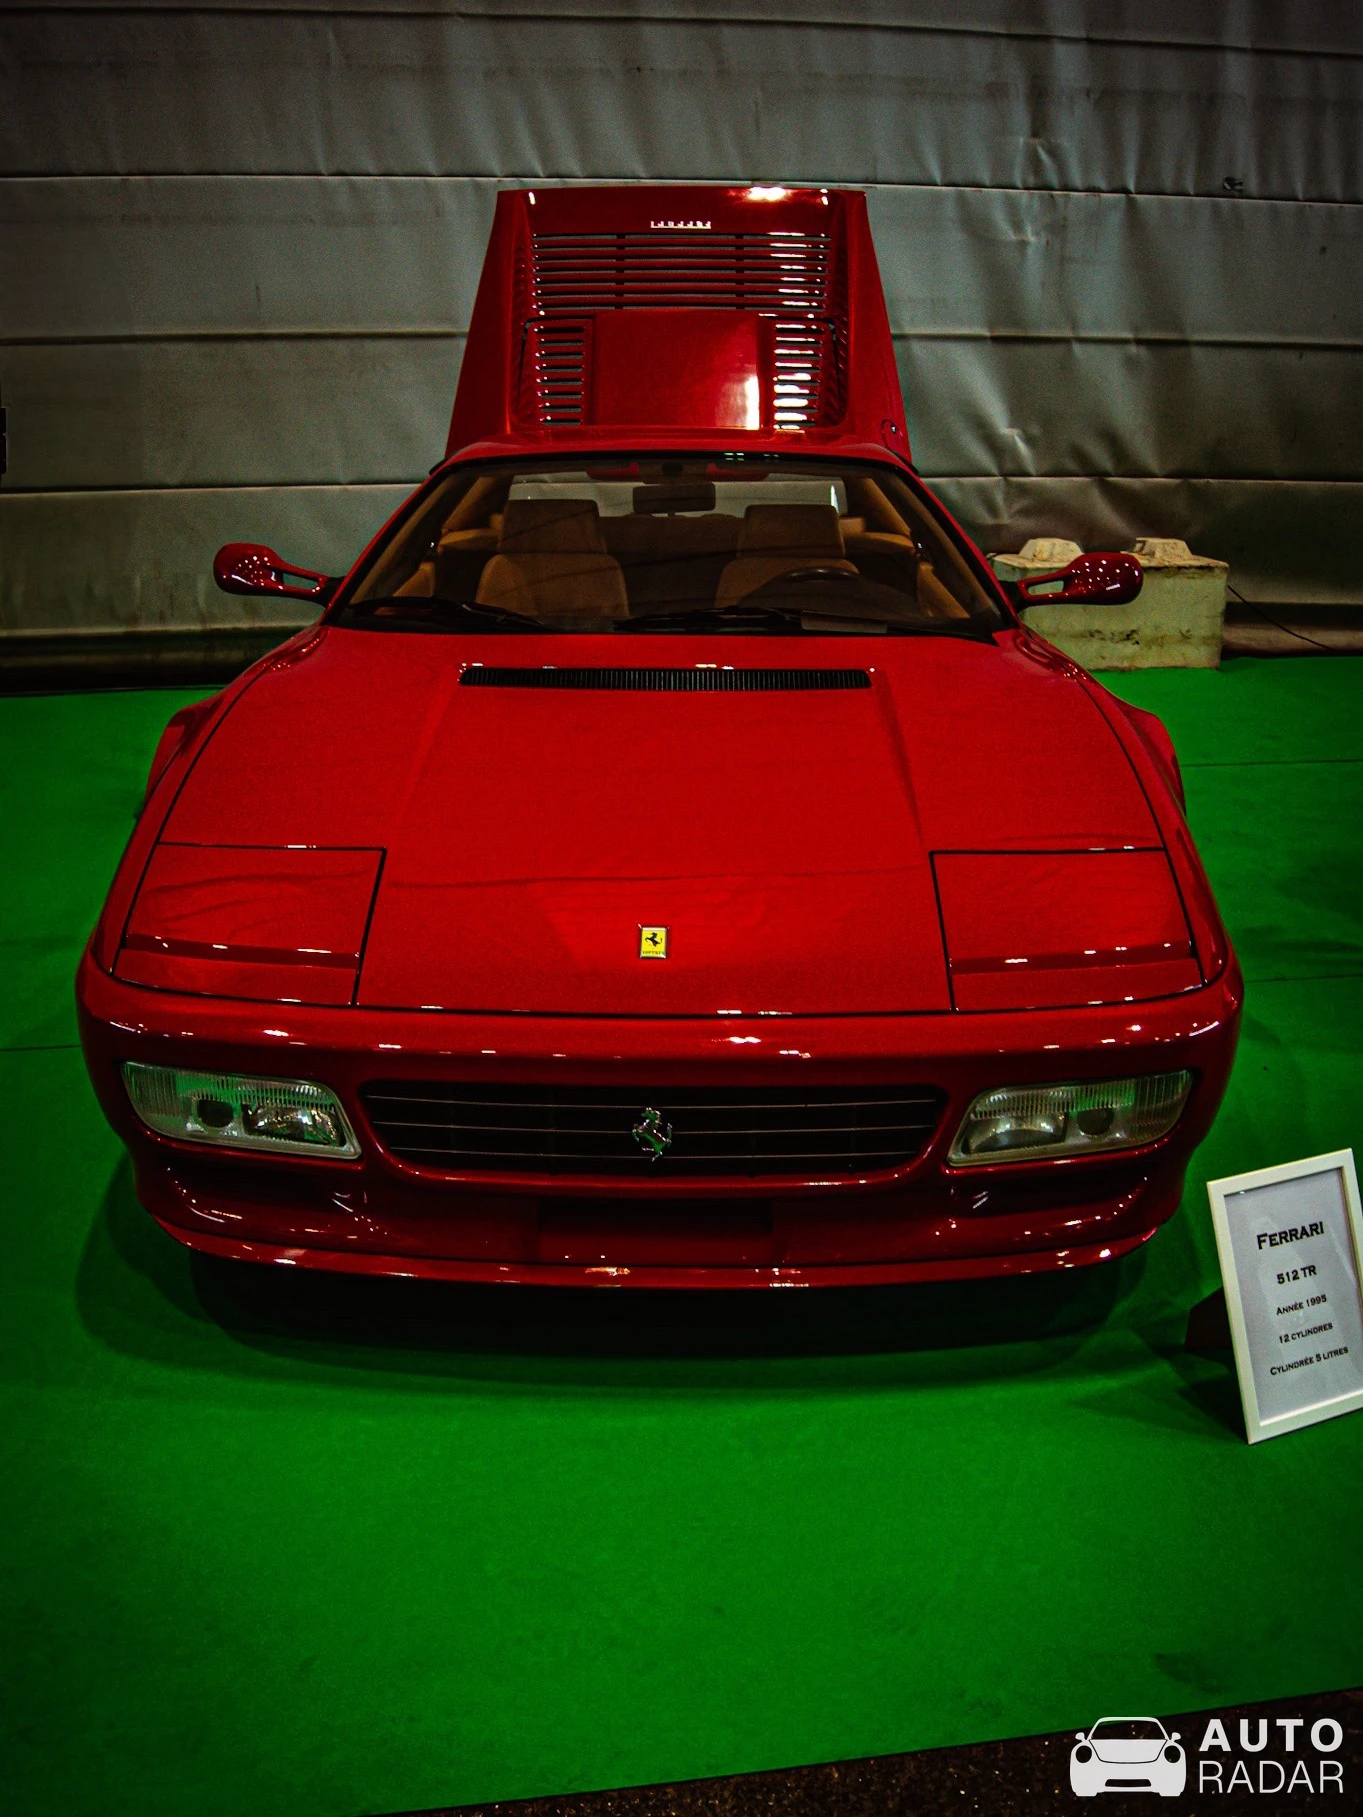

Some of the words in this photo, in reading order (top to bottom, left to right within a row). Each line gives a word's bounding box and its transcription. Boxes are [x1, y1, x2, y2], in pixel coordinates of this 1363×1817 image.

[1256, 1221, 1325, 1250] FERRARI
[1276, 1269, 1300, 1285] 512
[1301, 1264, 1317, 1278] TR
[1276, 1302, 1304, 1316] ANNÉE
[1306, 1294, 1327, 1307] 1995
[1279, 1334, 1290, 1344] 12
[1291, 1322, 1334, 1341] CYLINDRES
[1270, 1356, 1314, 1376] CYLINDRÉE
[1315, 1353, 1322, 1362] 5
[1322, 1346, 1349, 1361] LITRES
